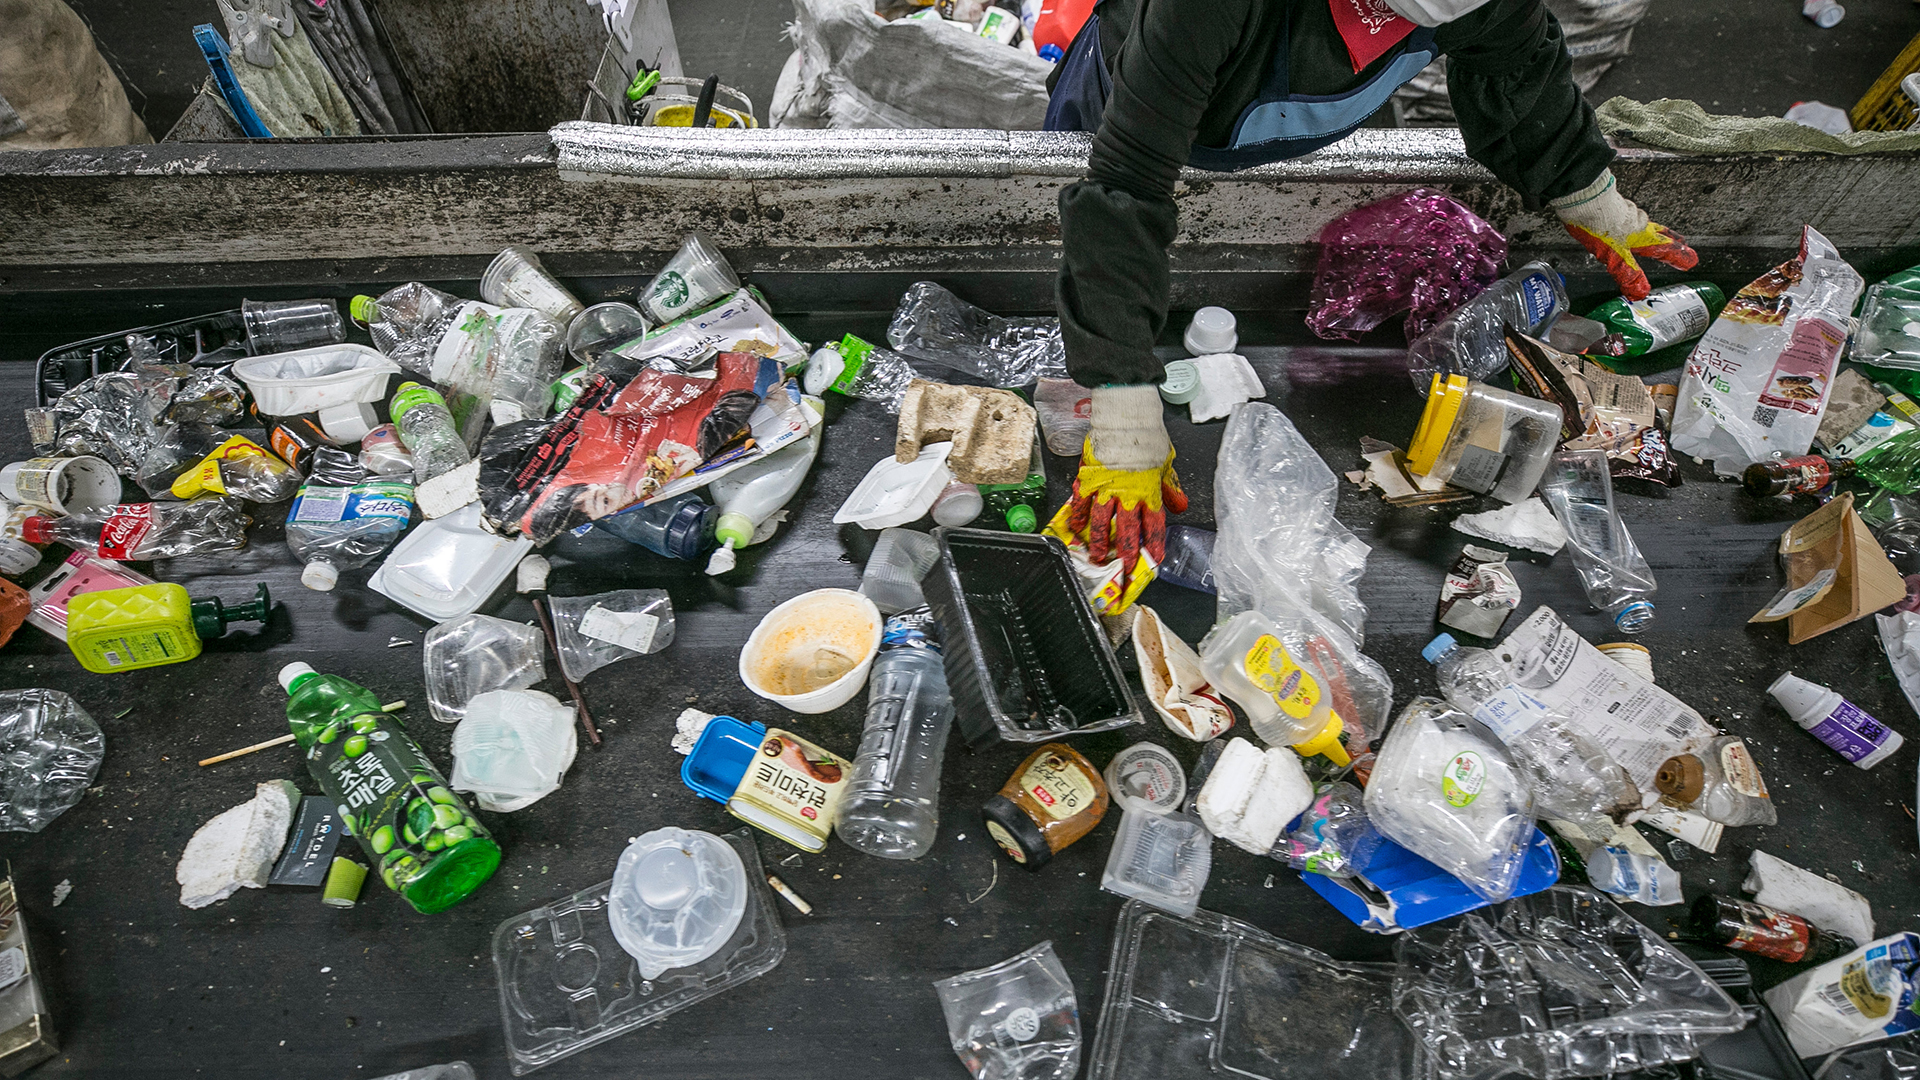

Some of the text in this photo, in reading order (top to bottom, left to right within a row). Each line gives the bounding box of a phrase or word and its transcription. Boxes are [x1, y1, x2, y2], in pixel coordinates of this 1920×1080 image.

[1529, 277, 1545, 319] MY WATER
[338, 751, 384, 795] 초록
[346, 767, 397, 809] 매실
[755, 761, 827, 809] 런천미트
